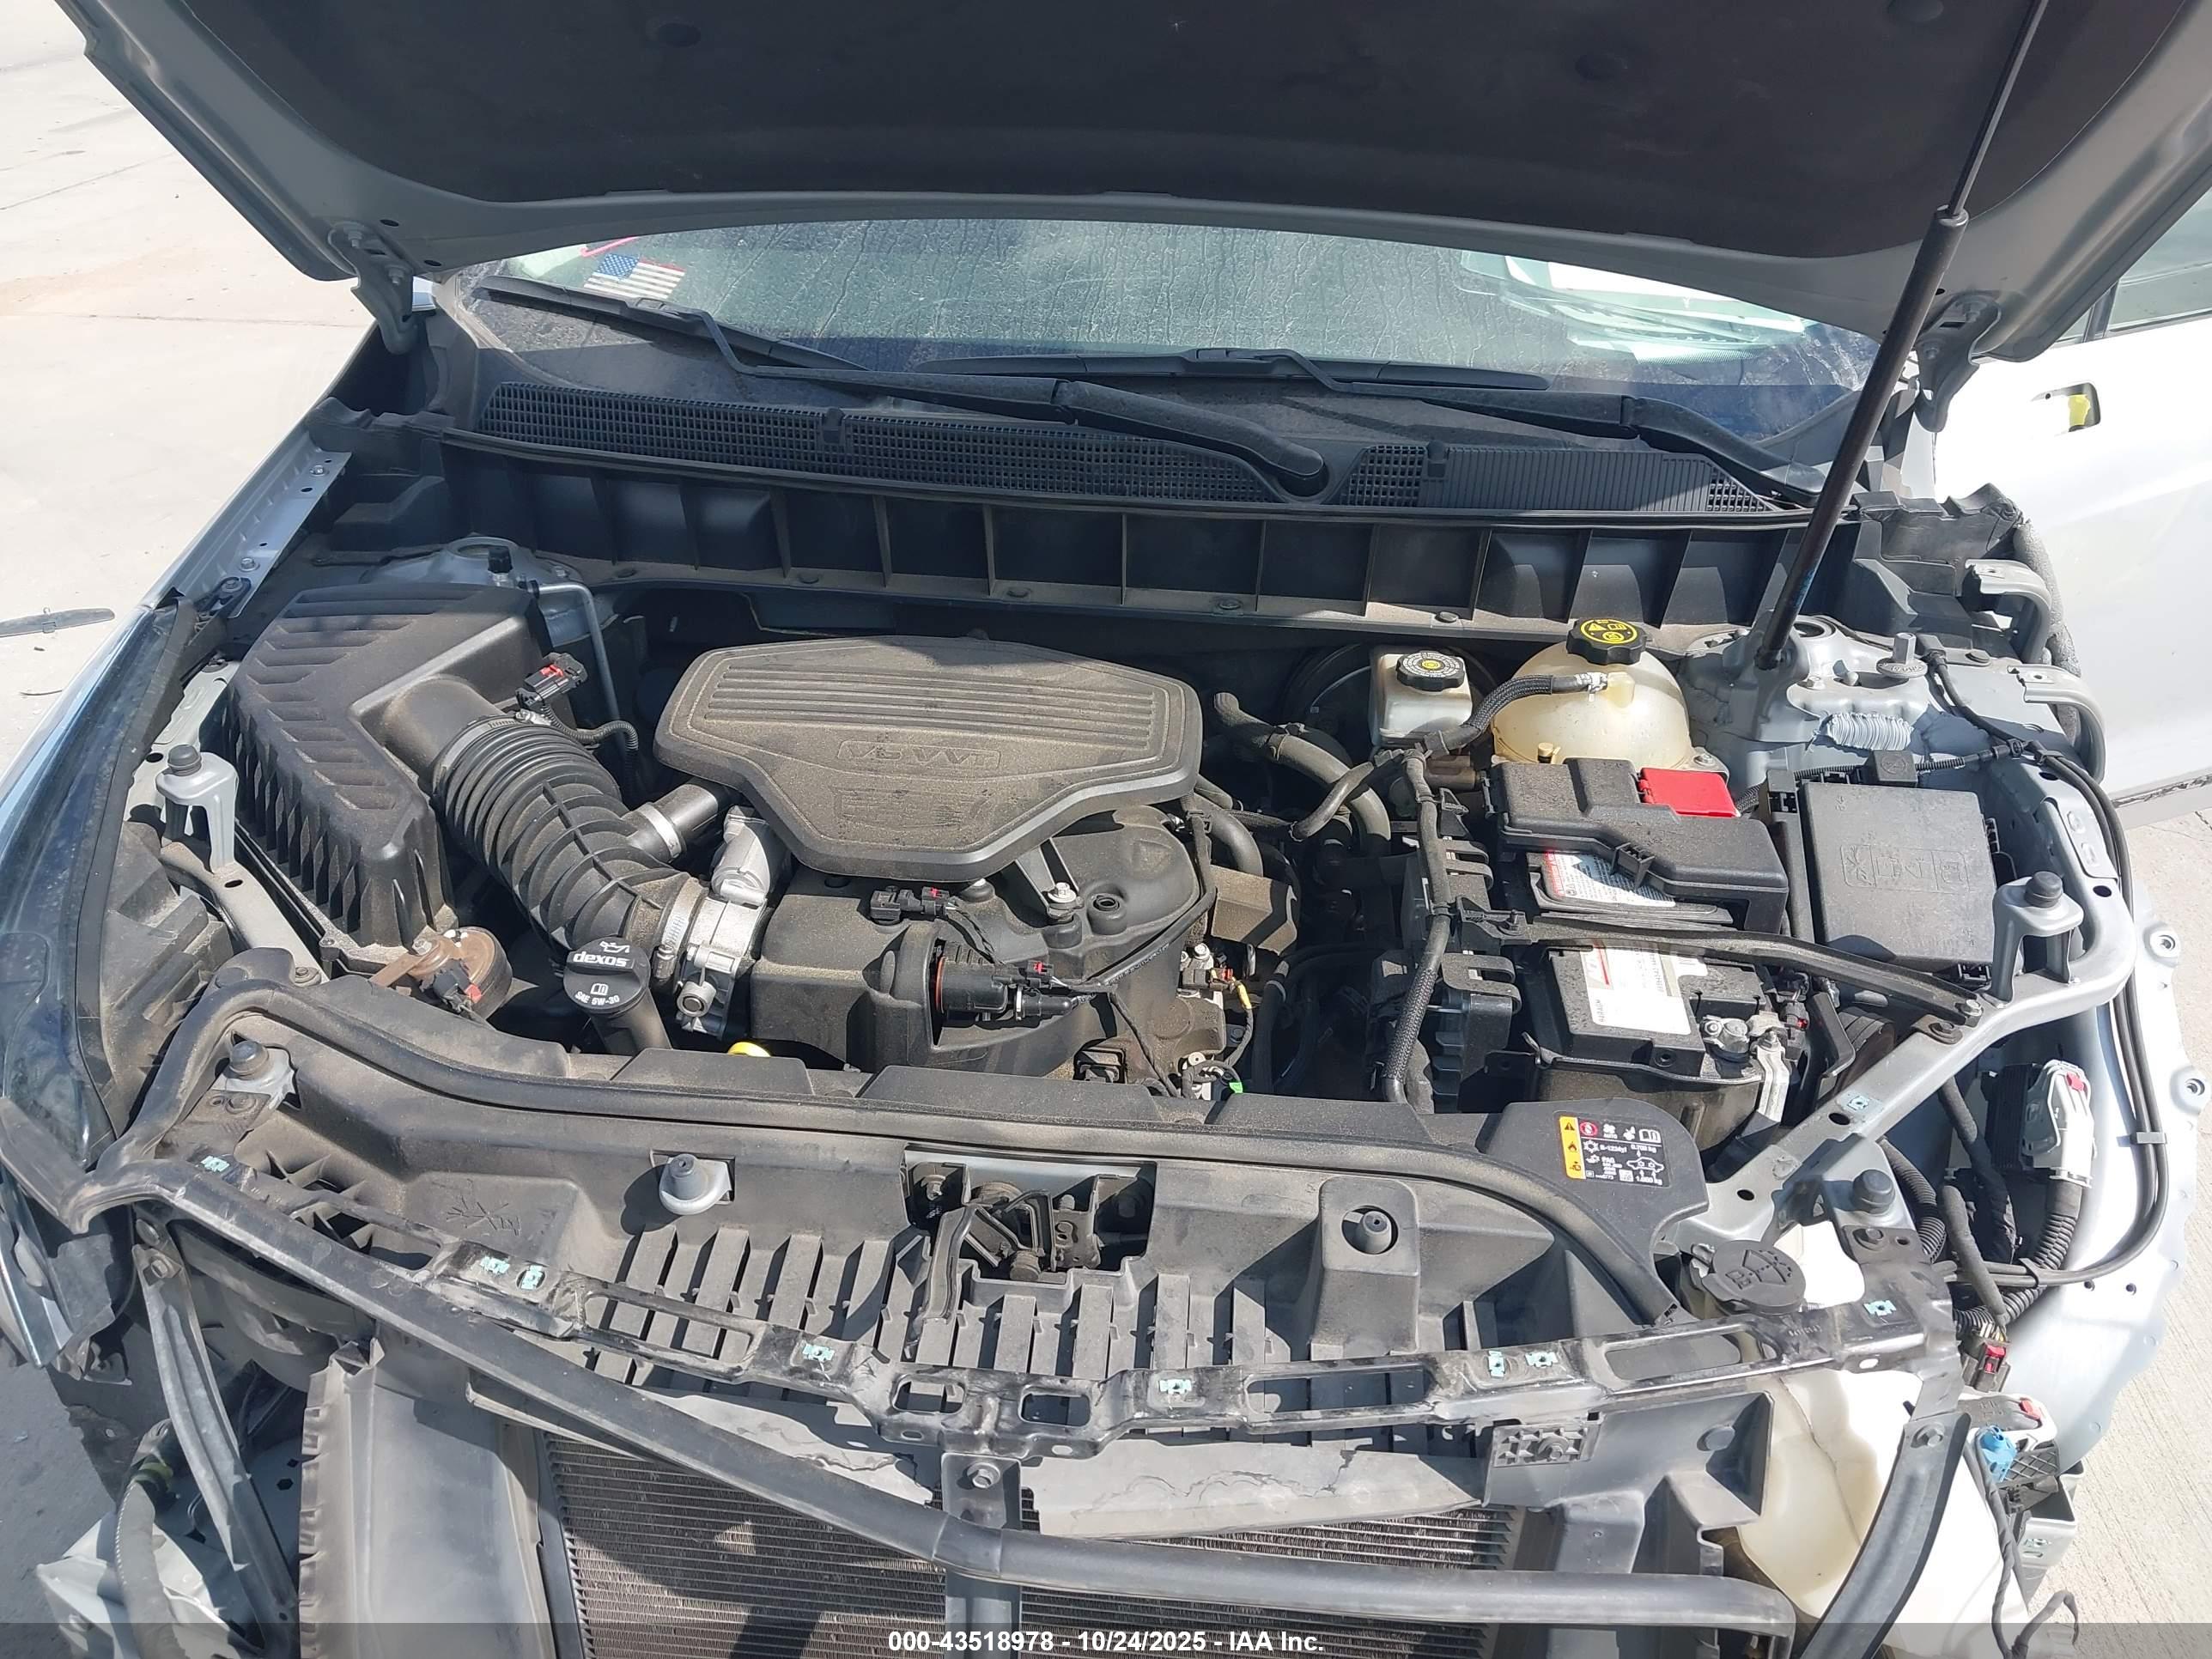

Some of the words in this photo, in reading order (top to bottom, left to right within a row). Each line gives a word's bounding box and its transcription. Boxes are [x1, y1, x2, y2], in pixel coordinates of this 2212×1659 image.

[573, 951, 628, 967] dexos
[574, 991, 591, 1003] SAE
[591, 994, 620, 1006] 5W-30
